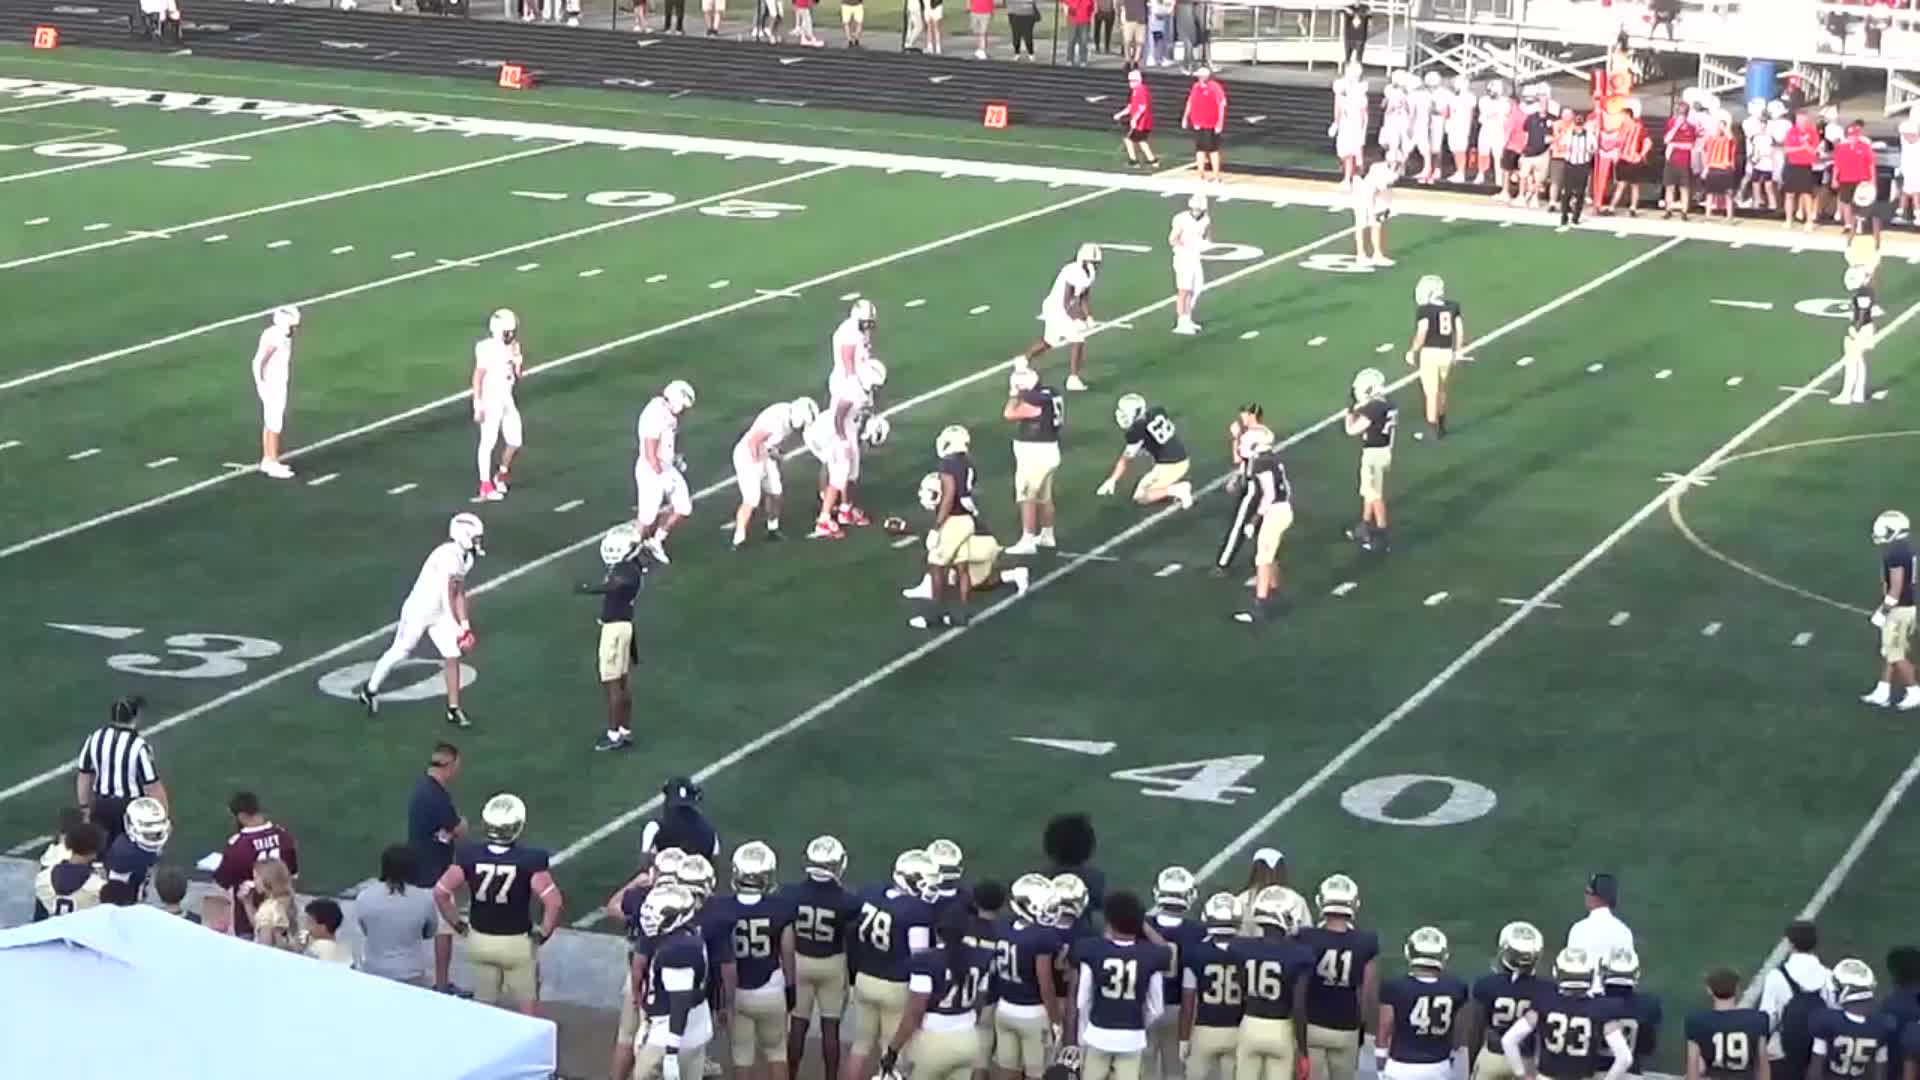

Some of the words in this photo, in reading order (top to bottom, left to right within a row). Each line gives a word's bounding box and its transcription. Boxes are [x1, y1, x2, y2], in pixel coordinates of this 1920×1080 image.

[1439, 311, 1452, 336] 8
[1110, 754, 1497, 827] 40
[475, 863, 517, 904] 77
[735, 918, 771, 958] 65
[795, 905, 837, 942] 25
[858, 902, 893, 952] 78
[996, 940, 1022, 984] 21
[1101, 957, 1138, 1000] 31
[1245, 959, 1282, 1000] 16
[1316, 949, 1353, 987] 41
[1202, 963, 1242, 1005] 36
[1409, 996, 1453, 1036] 43
[1545, 1012, 1592, 1056] 33
[1711, 1032, 1749, 1071] 19
[1829, 1035, 1878, 1077] 35
